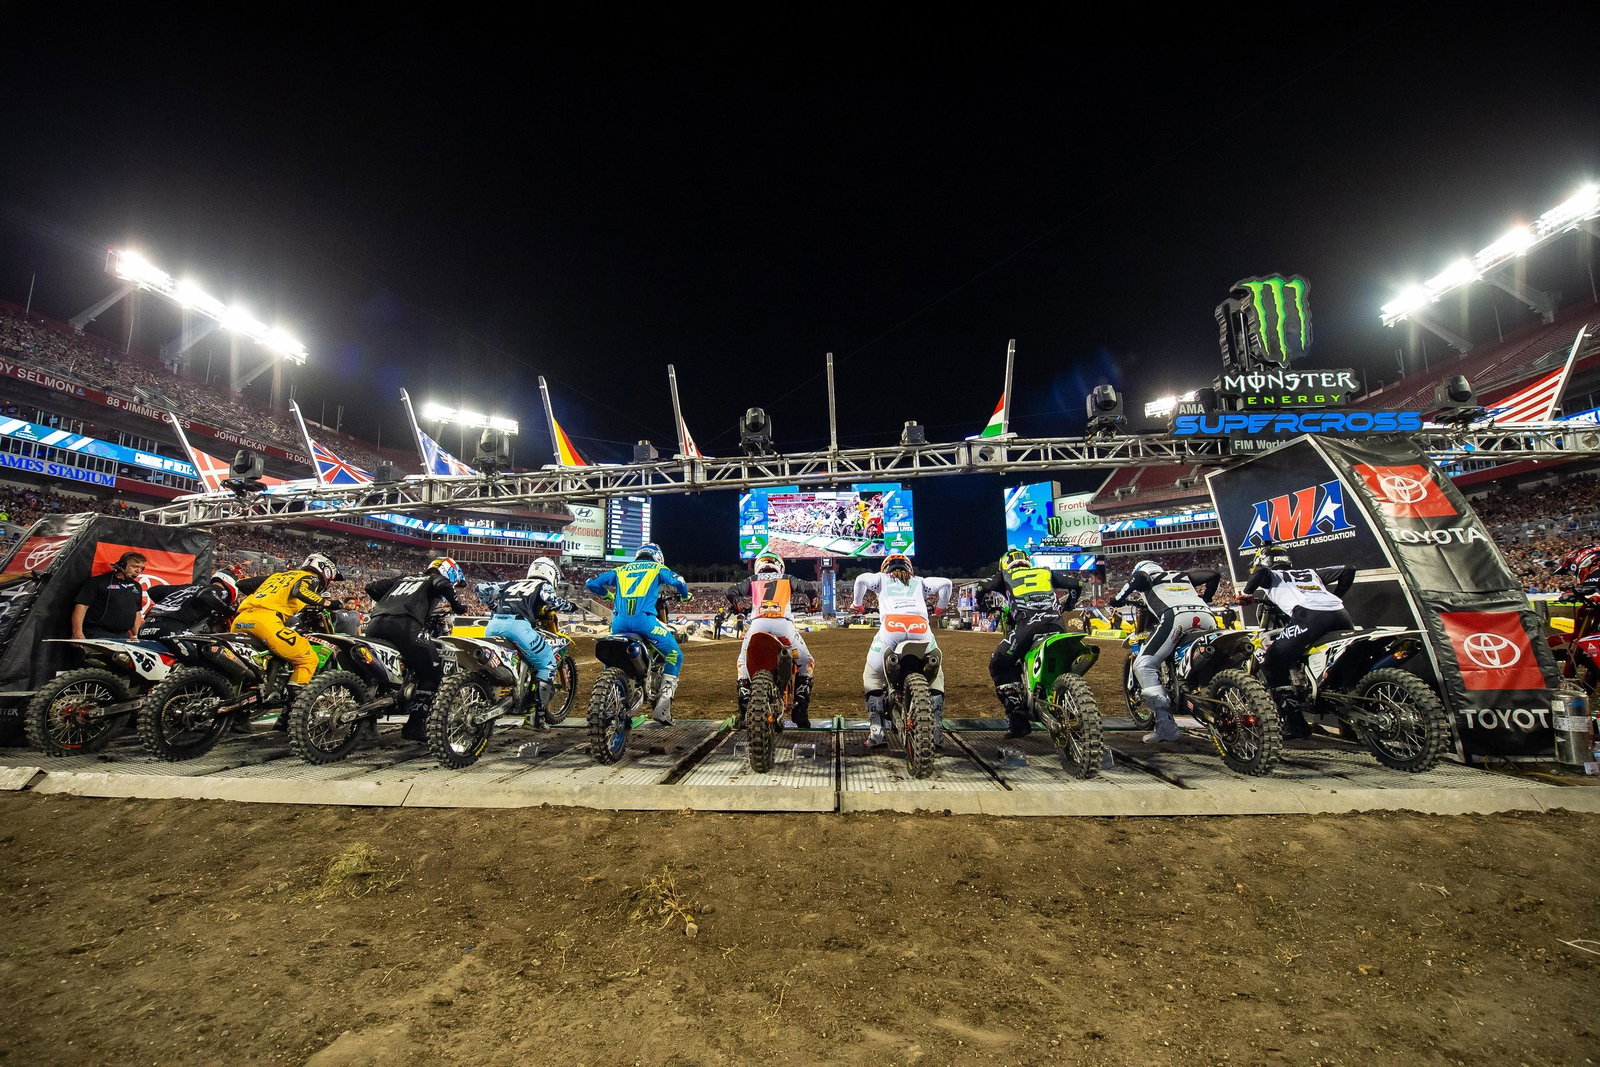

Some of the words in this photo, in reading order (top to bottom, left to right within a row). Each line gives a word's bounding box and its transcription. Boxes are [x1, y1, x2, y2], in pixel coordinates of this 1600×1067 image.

[17, 368, 75, 394] SELMON
[1223, 371, 1356, 393] MONSTER
[1178, 403, 1205, 415] AMA
[1247, 394, 1341, 405] ENERGY
[107, 396, 120, 408] 88
[123, 402, 159, 420] JIMMIE
[162, 413, 191, 429] GES
[1174, 411, 1422, 435] SUPERCROSS
[214, 431, 239, 445] JOHN
[239, 437, 267, 453] MCKAY
[1234, 439, 1254, 450] FIM
[285, 452, 294, 460] 12
[0, 453, 44, 473] AMES
[47, 463, 116, 487] STADIUM
[1238, 479, 1356, 549] AMA
[1310, 530, 1356, 545] ASSOCIATION
[1385, 526, 1489, 545] TOYOTA
[626, 571, 649, 596] 7
[1012, 568, 1052, 596] 3
[1148, 572, 1191, 584] 22
[1281, 569, 1313, 583] 15
[505, 581, 542, 596] 44
[763, 581, 778, 601] 1
[548, 638, 568, 646] ZUKI
[1459, 708, 1550, 730] TOYOT
